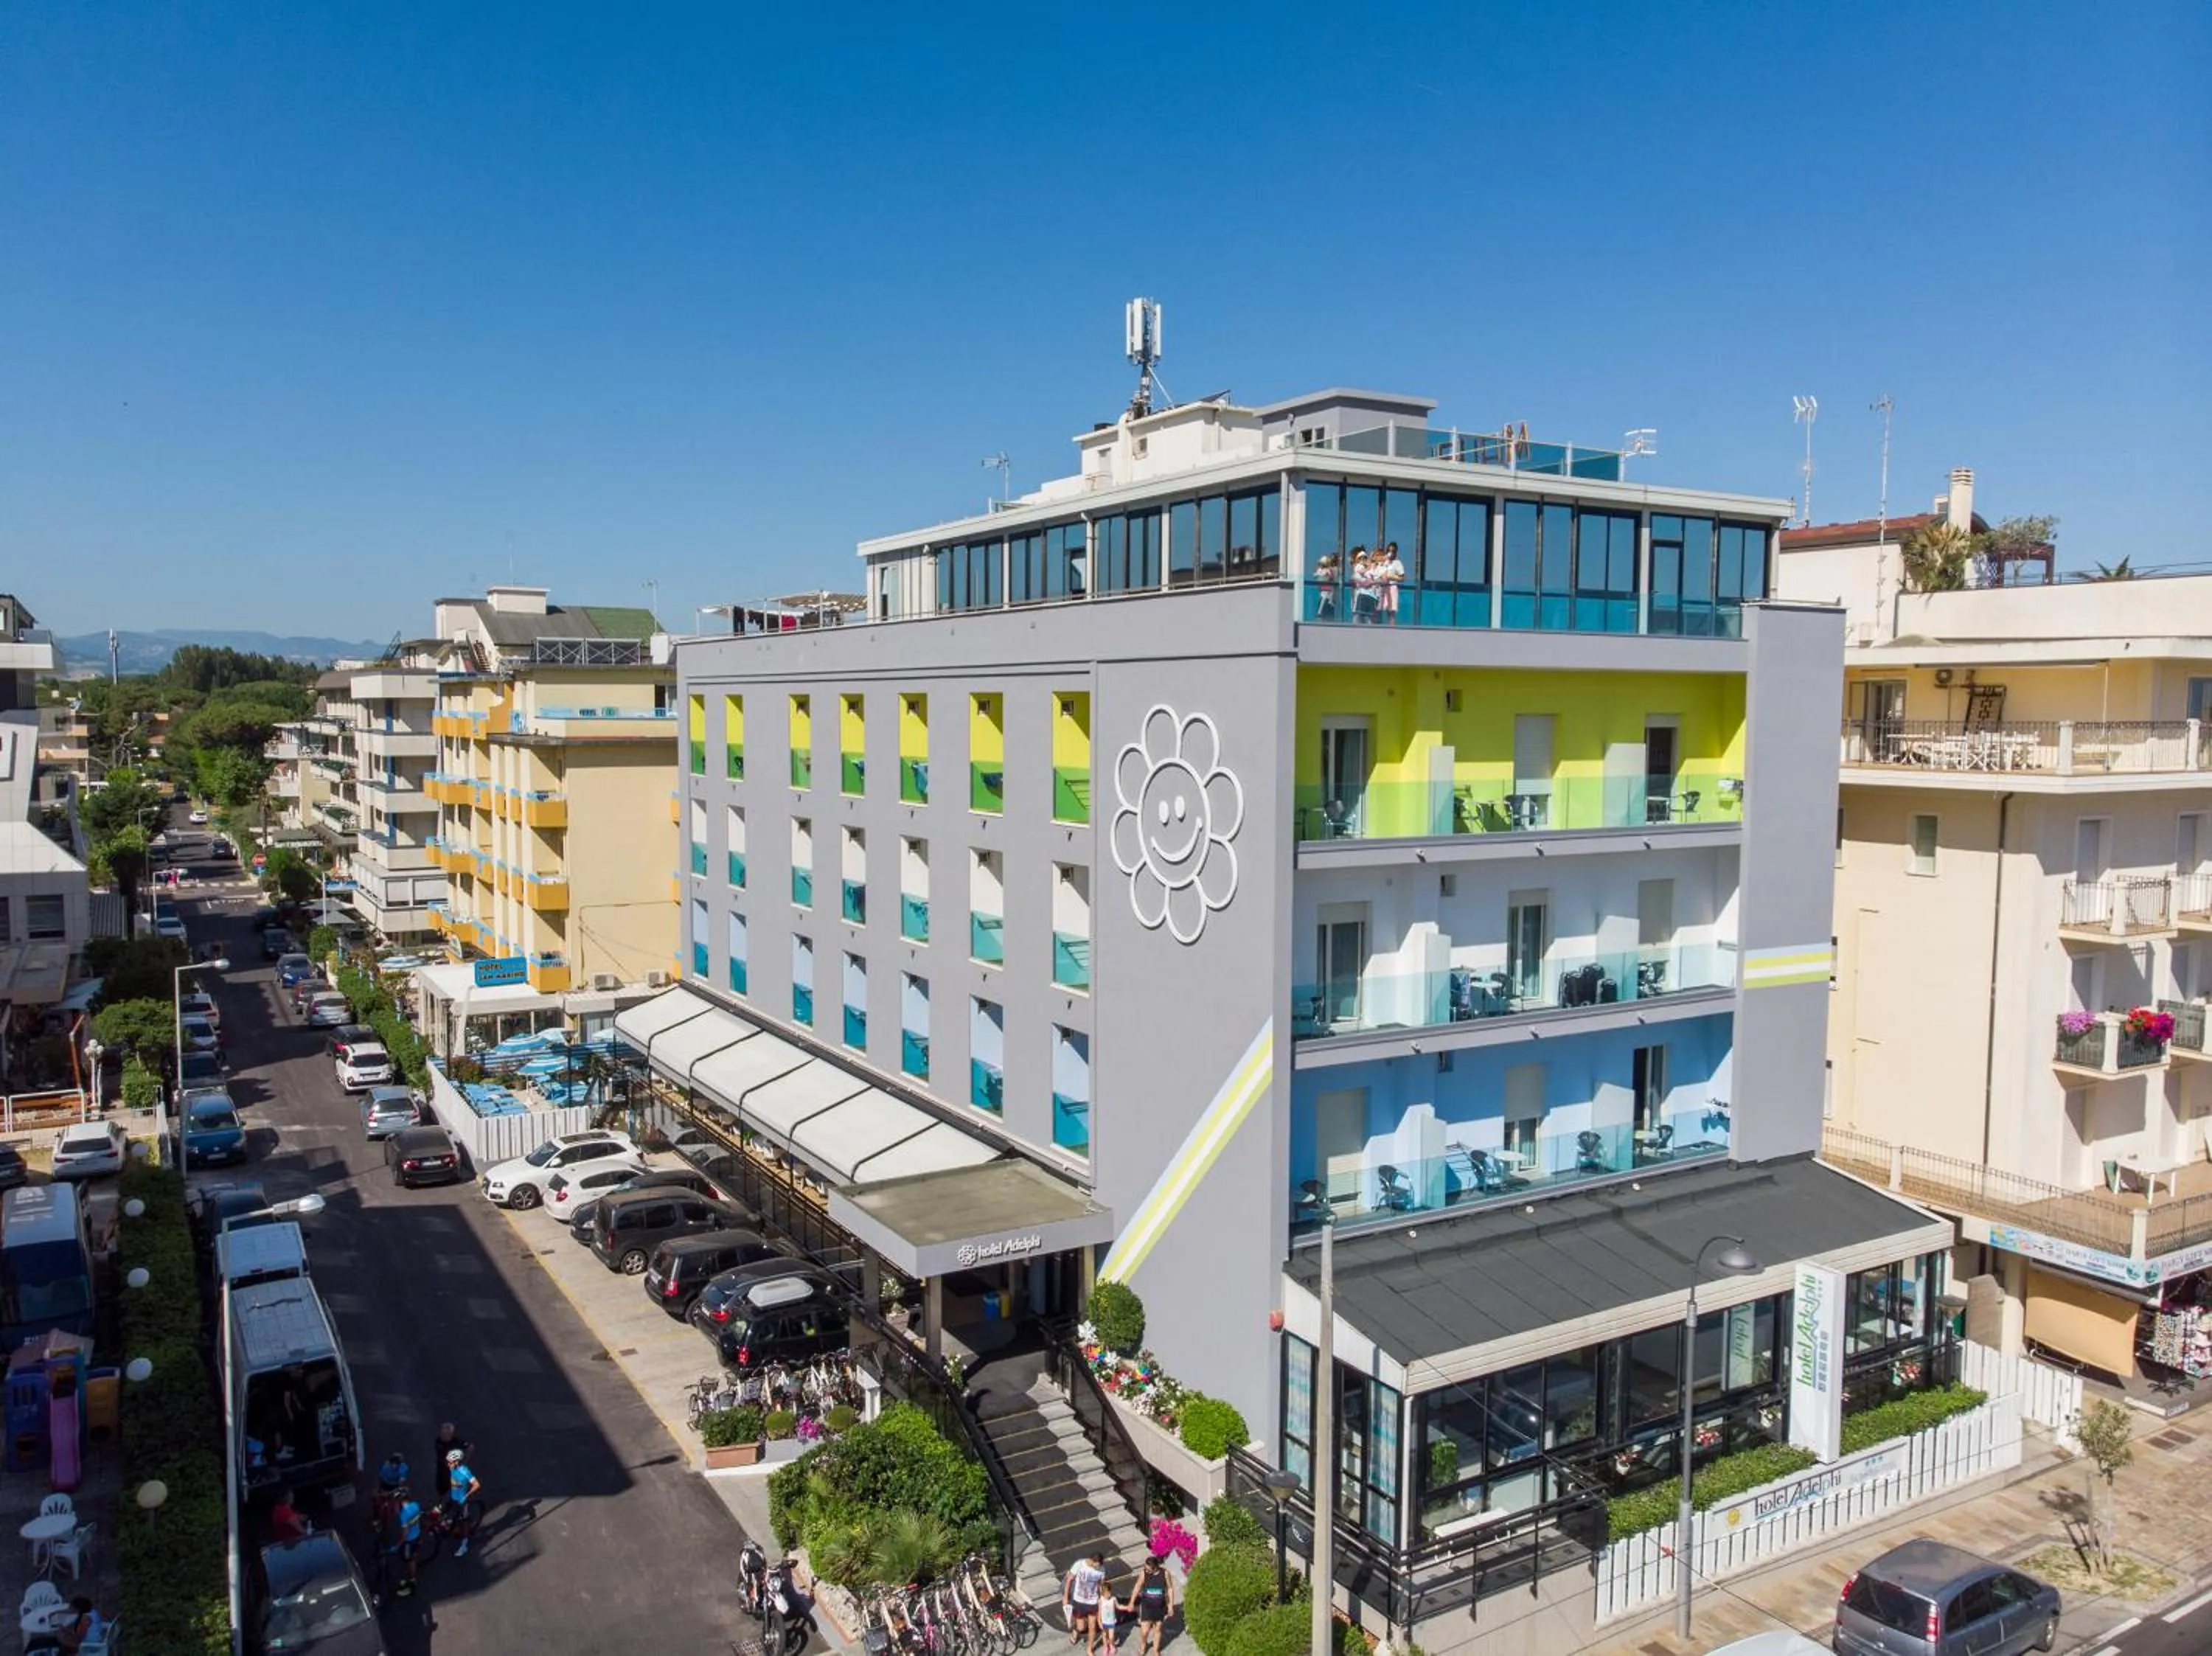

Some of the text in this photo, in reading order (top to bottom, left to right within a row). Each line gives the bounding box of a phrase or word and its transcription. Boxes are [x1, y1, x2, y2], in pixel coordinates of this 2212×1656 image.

[977, 1234, 1041, 1259] hotel Adelphi
[1795, 1273, 1819, 1387] hotel Adelphi
[1755, 1487, 1788, 1516] hotel
[1788, 1470, 1842, 1508] Adelphi
